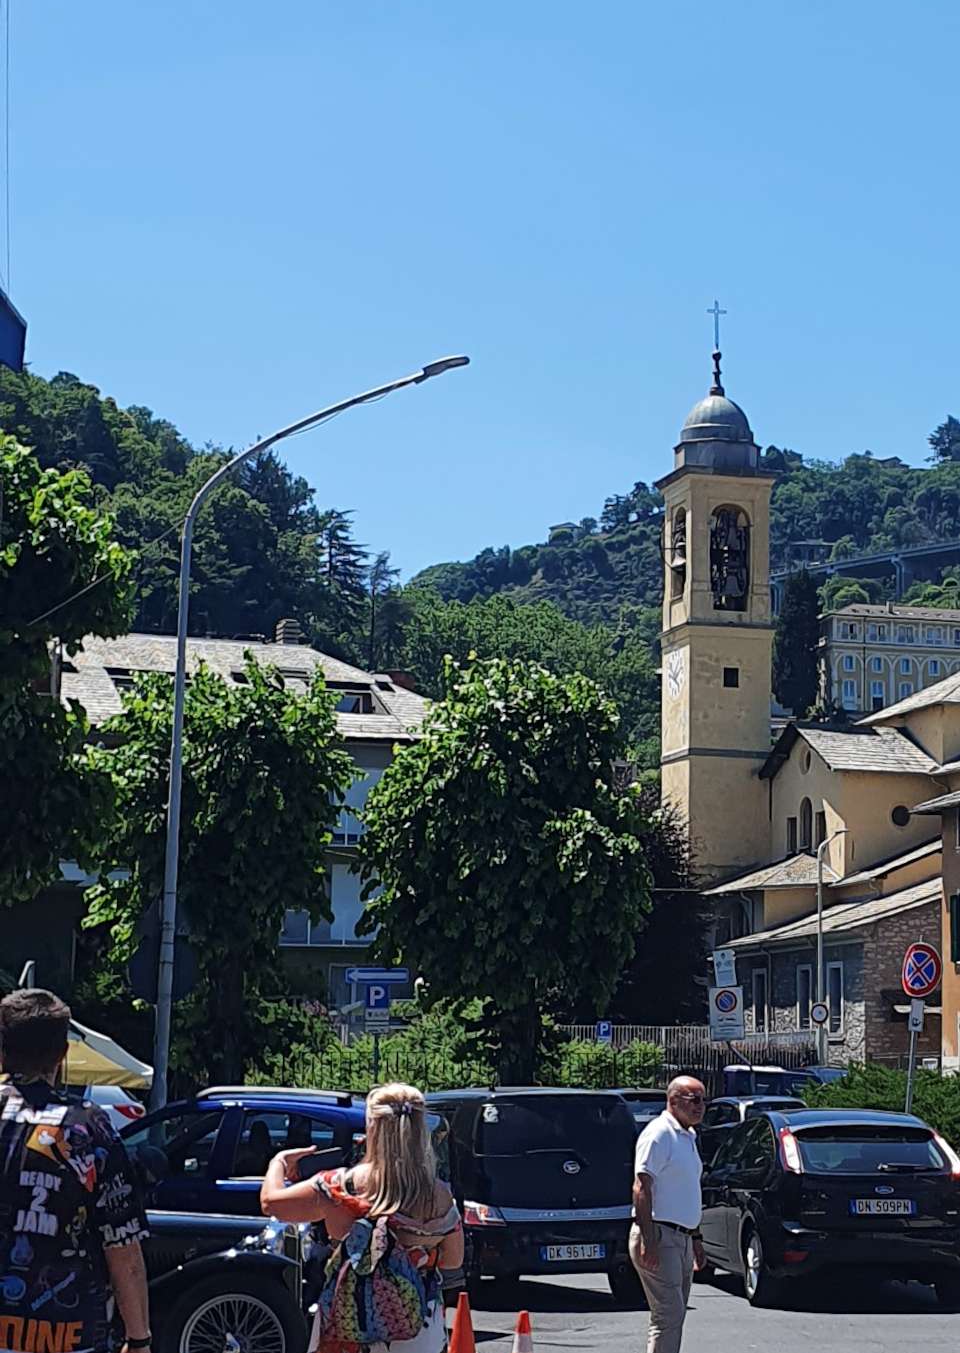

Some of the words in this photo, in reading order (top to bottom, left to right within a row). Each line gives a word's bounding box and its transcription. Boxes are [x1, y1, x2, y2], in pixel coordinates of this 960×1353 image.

[369, 986, 385, 1006] P
[600, 1023, 609, 1035] P
[19, 1170, 62, 1192] READY
[30, 1186, 48, 1212] 2
[13, 1209, 58, 1236] JAM
